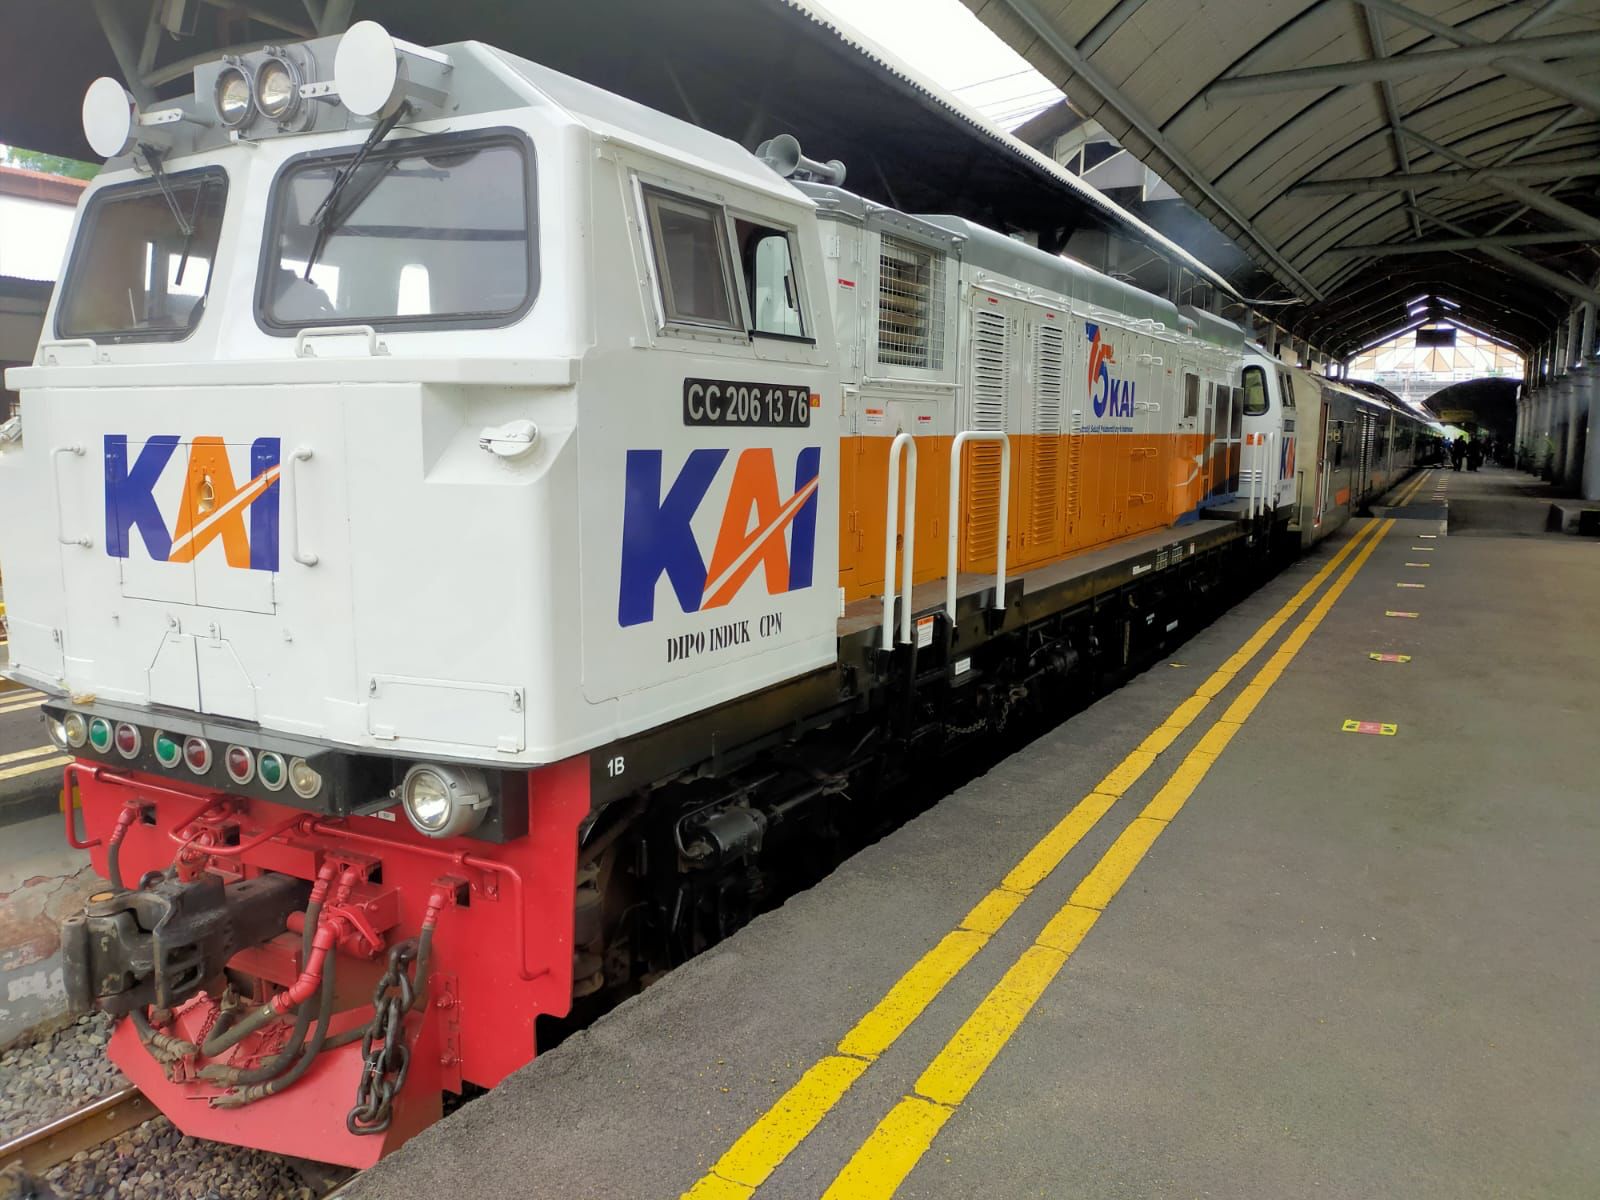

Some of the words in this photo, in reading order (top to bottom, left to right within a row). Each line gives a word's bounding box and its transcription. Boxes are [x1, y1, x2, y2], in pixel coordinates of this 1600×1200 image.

[688, 384, 721, 421] CC
[725, 386, 761, 422] 206
[765, 389, 784, 422] 13
[788, 390, 808, 423] 76
[1109, 379, 1136, 418] KAI
[104, 434, 281, 572] KAI
[618, 446, 821, 628] KAI
[666, 631, 705, 663] DIPO
[709, 620, 751, 652] INDUK
[759, 612, 782, 638] CPN
[607, 756, 625, 778] 1B
